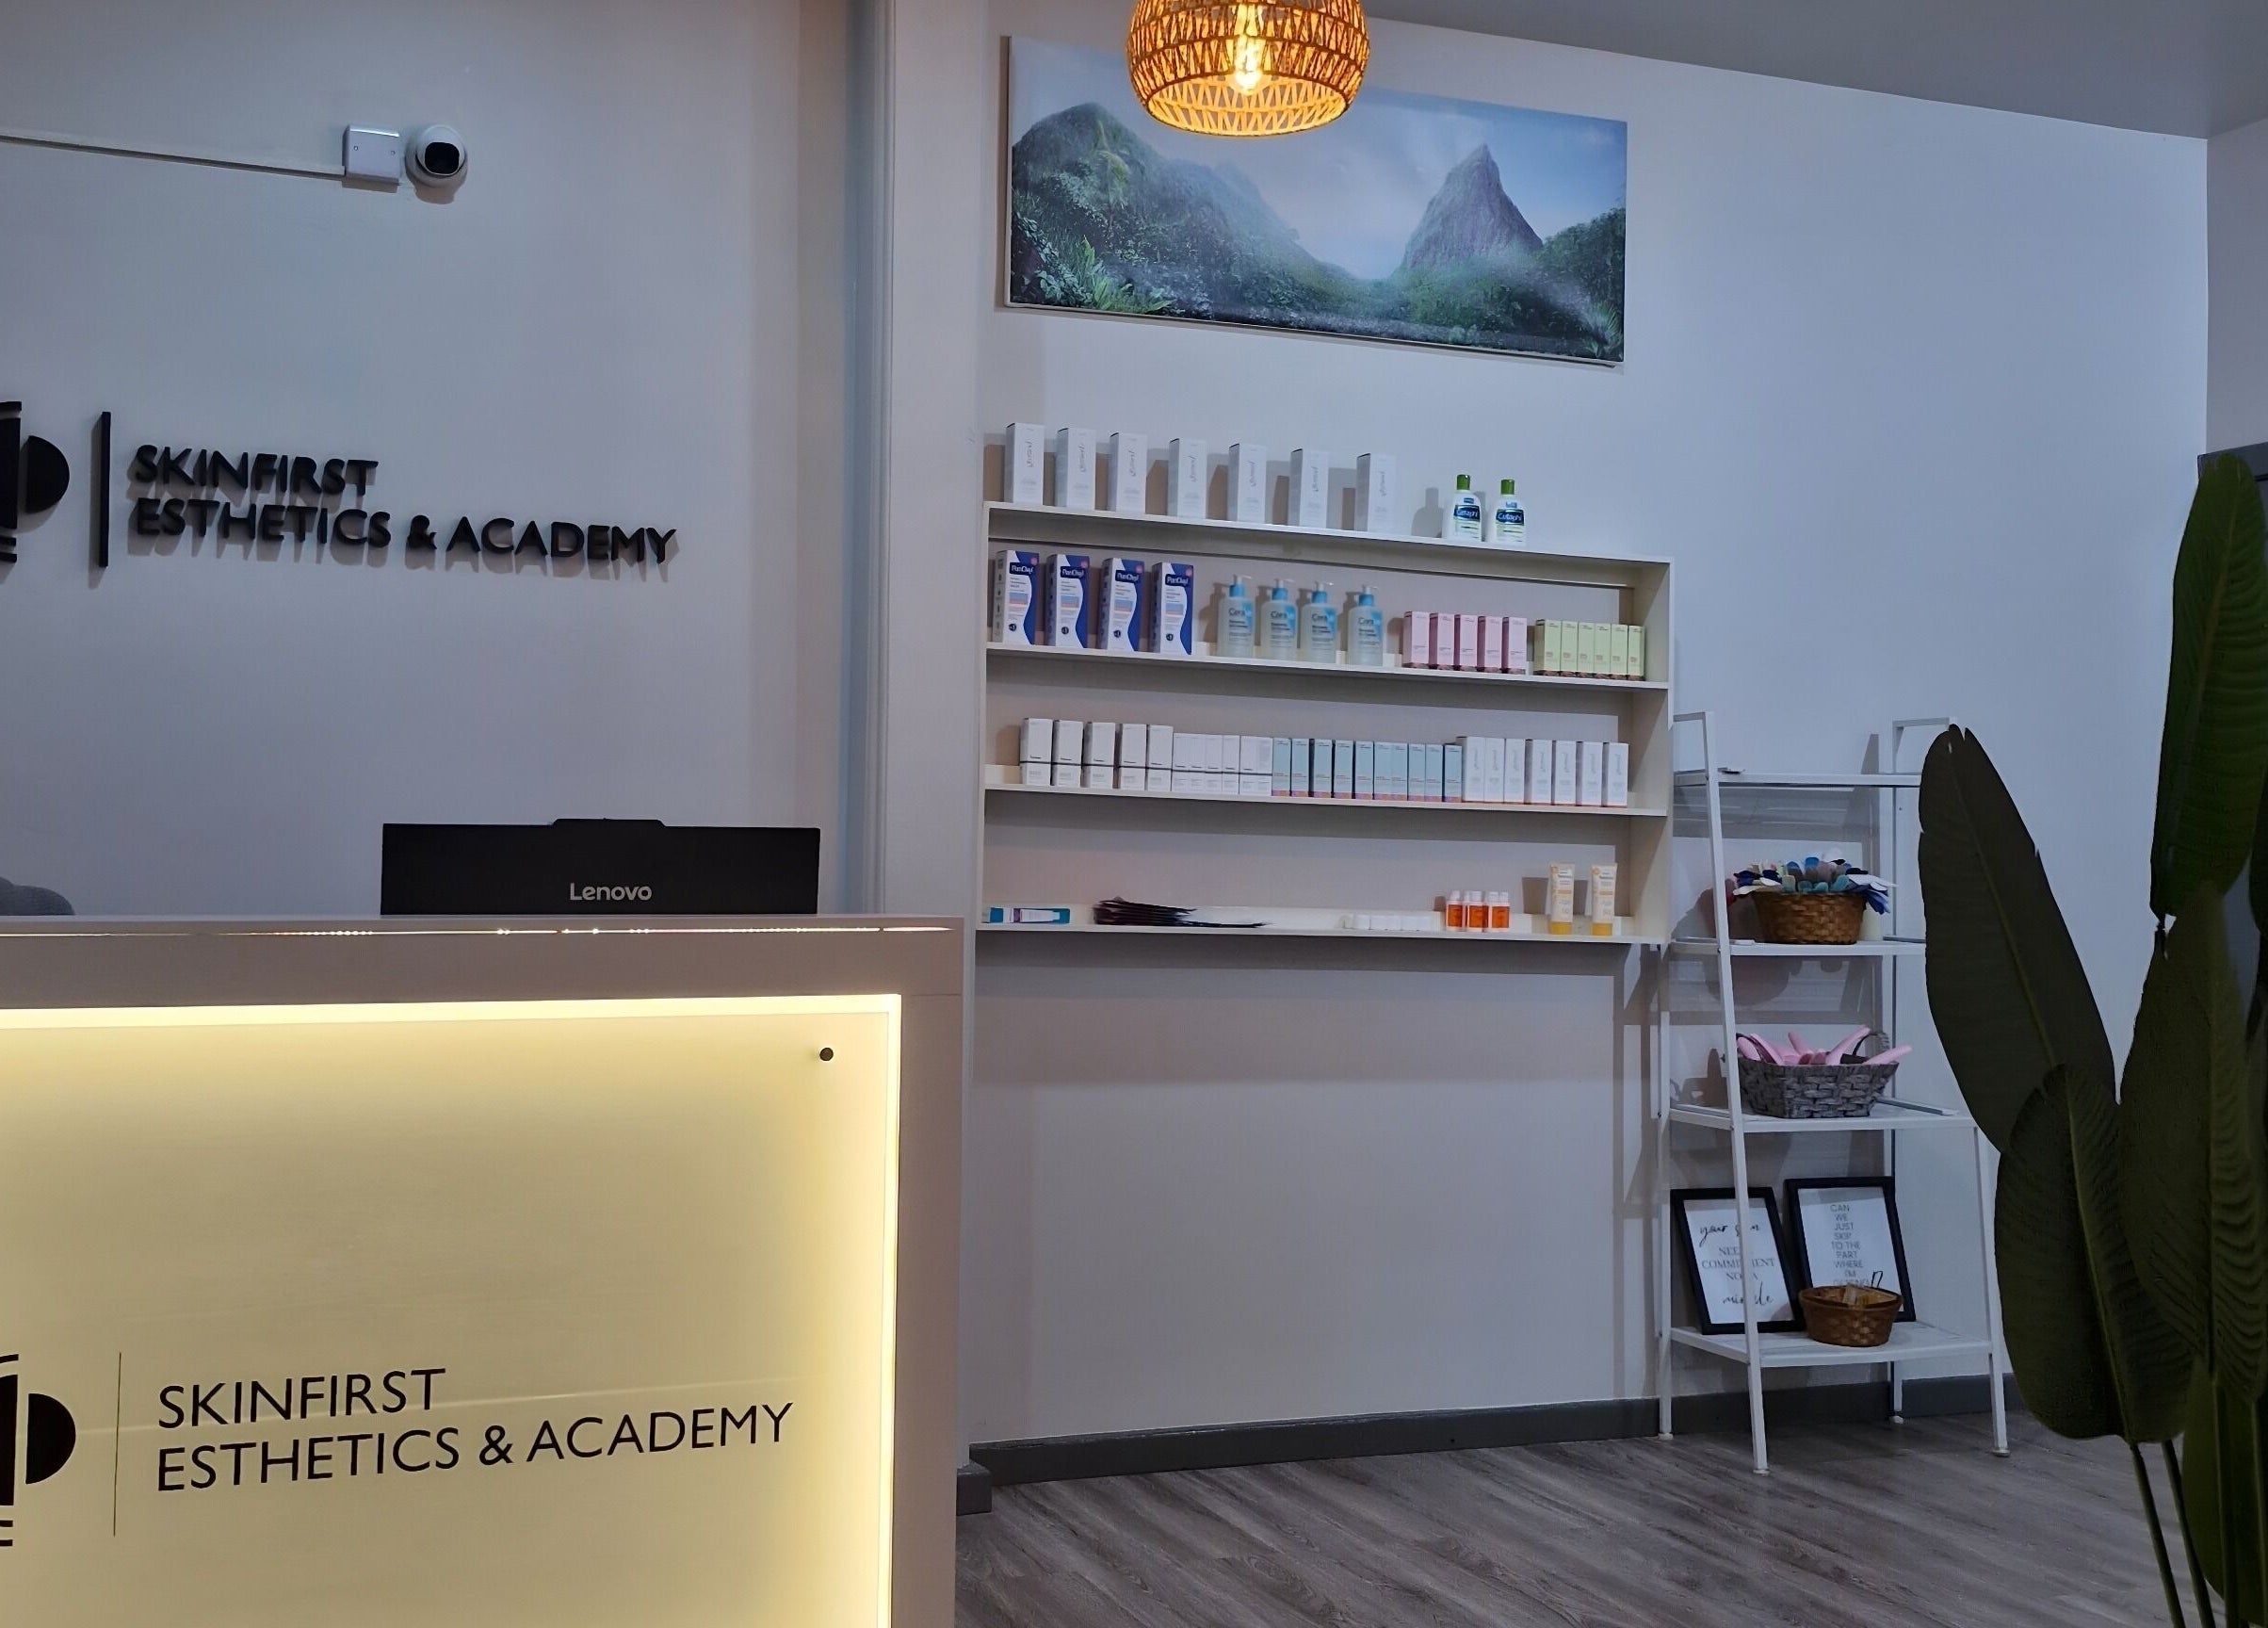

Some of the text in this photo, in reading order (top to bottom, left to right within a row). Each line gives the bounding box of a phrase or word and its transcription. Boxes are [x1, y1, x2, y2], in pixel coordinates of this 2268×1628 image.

[136, 445, 379, 496] SKINFIRST
[138, 497, 676, 564] ESTHETICS & ACADEMY
[570, 883, 653, 901] Lenovo
[1830, 1204, 1850, 1213] CAN
[1834, 1222, 1854, 1230] JUST
[1834, 1231, 1852, 1240] SKIP
[1831, 1241, 1861, 1250] TO THE
[1834, 1260, 1864, 1268] WHERE
[158, 1368, 446, 1428] SKINFIRST
[158, 1402, 793, 1491] ESTHETICS & ACADEMY
